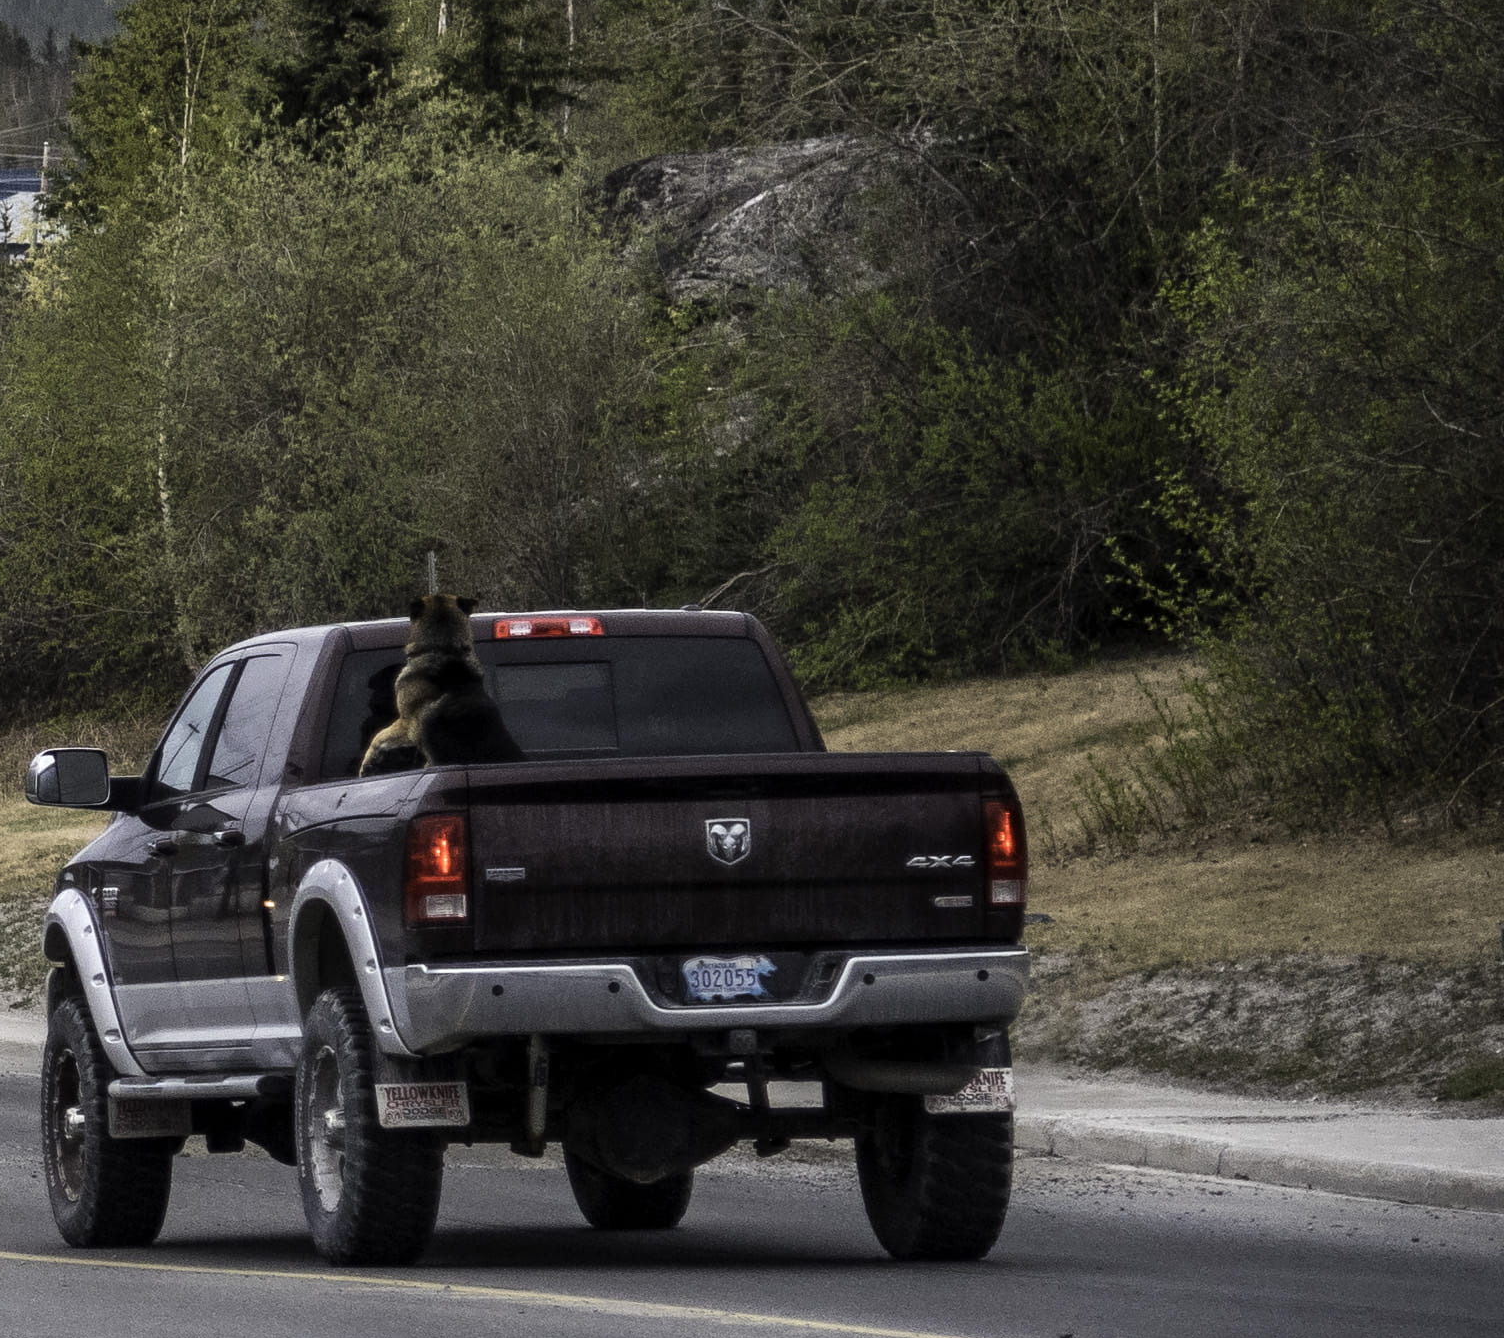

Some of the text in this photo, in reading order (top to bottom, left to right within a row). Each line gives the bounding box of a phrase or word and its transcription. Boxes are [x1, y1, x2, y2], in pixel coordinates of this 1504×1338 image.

[690, 969, 756, 988] 302055
[384, 1085, 460, 1101] YELLOWKNIFE
[386, 1099, 459, 1109] CHRYSLER
